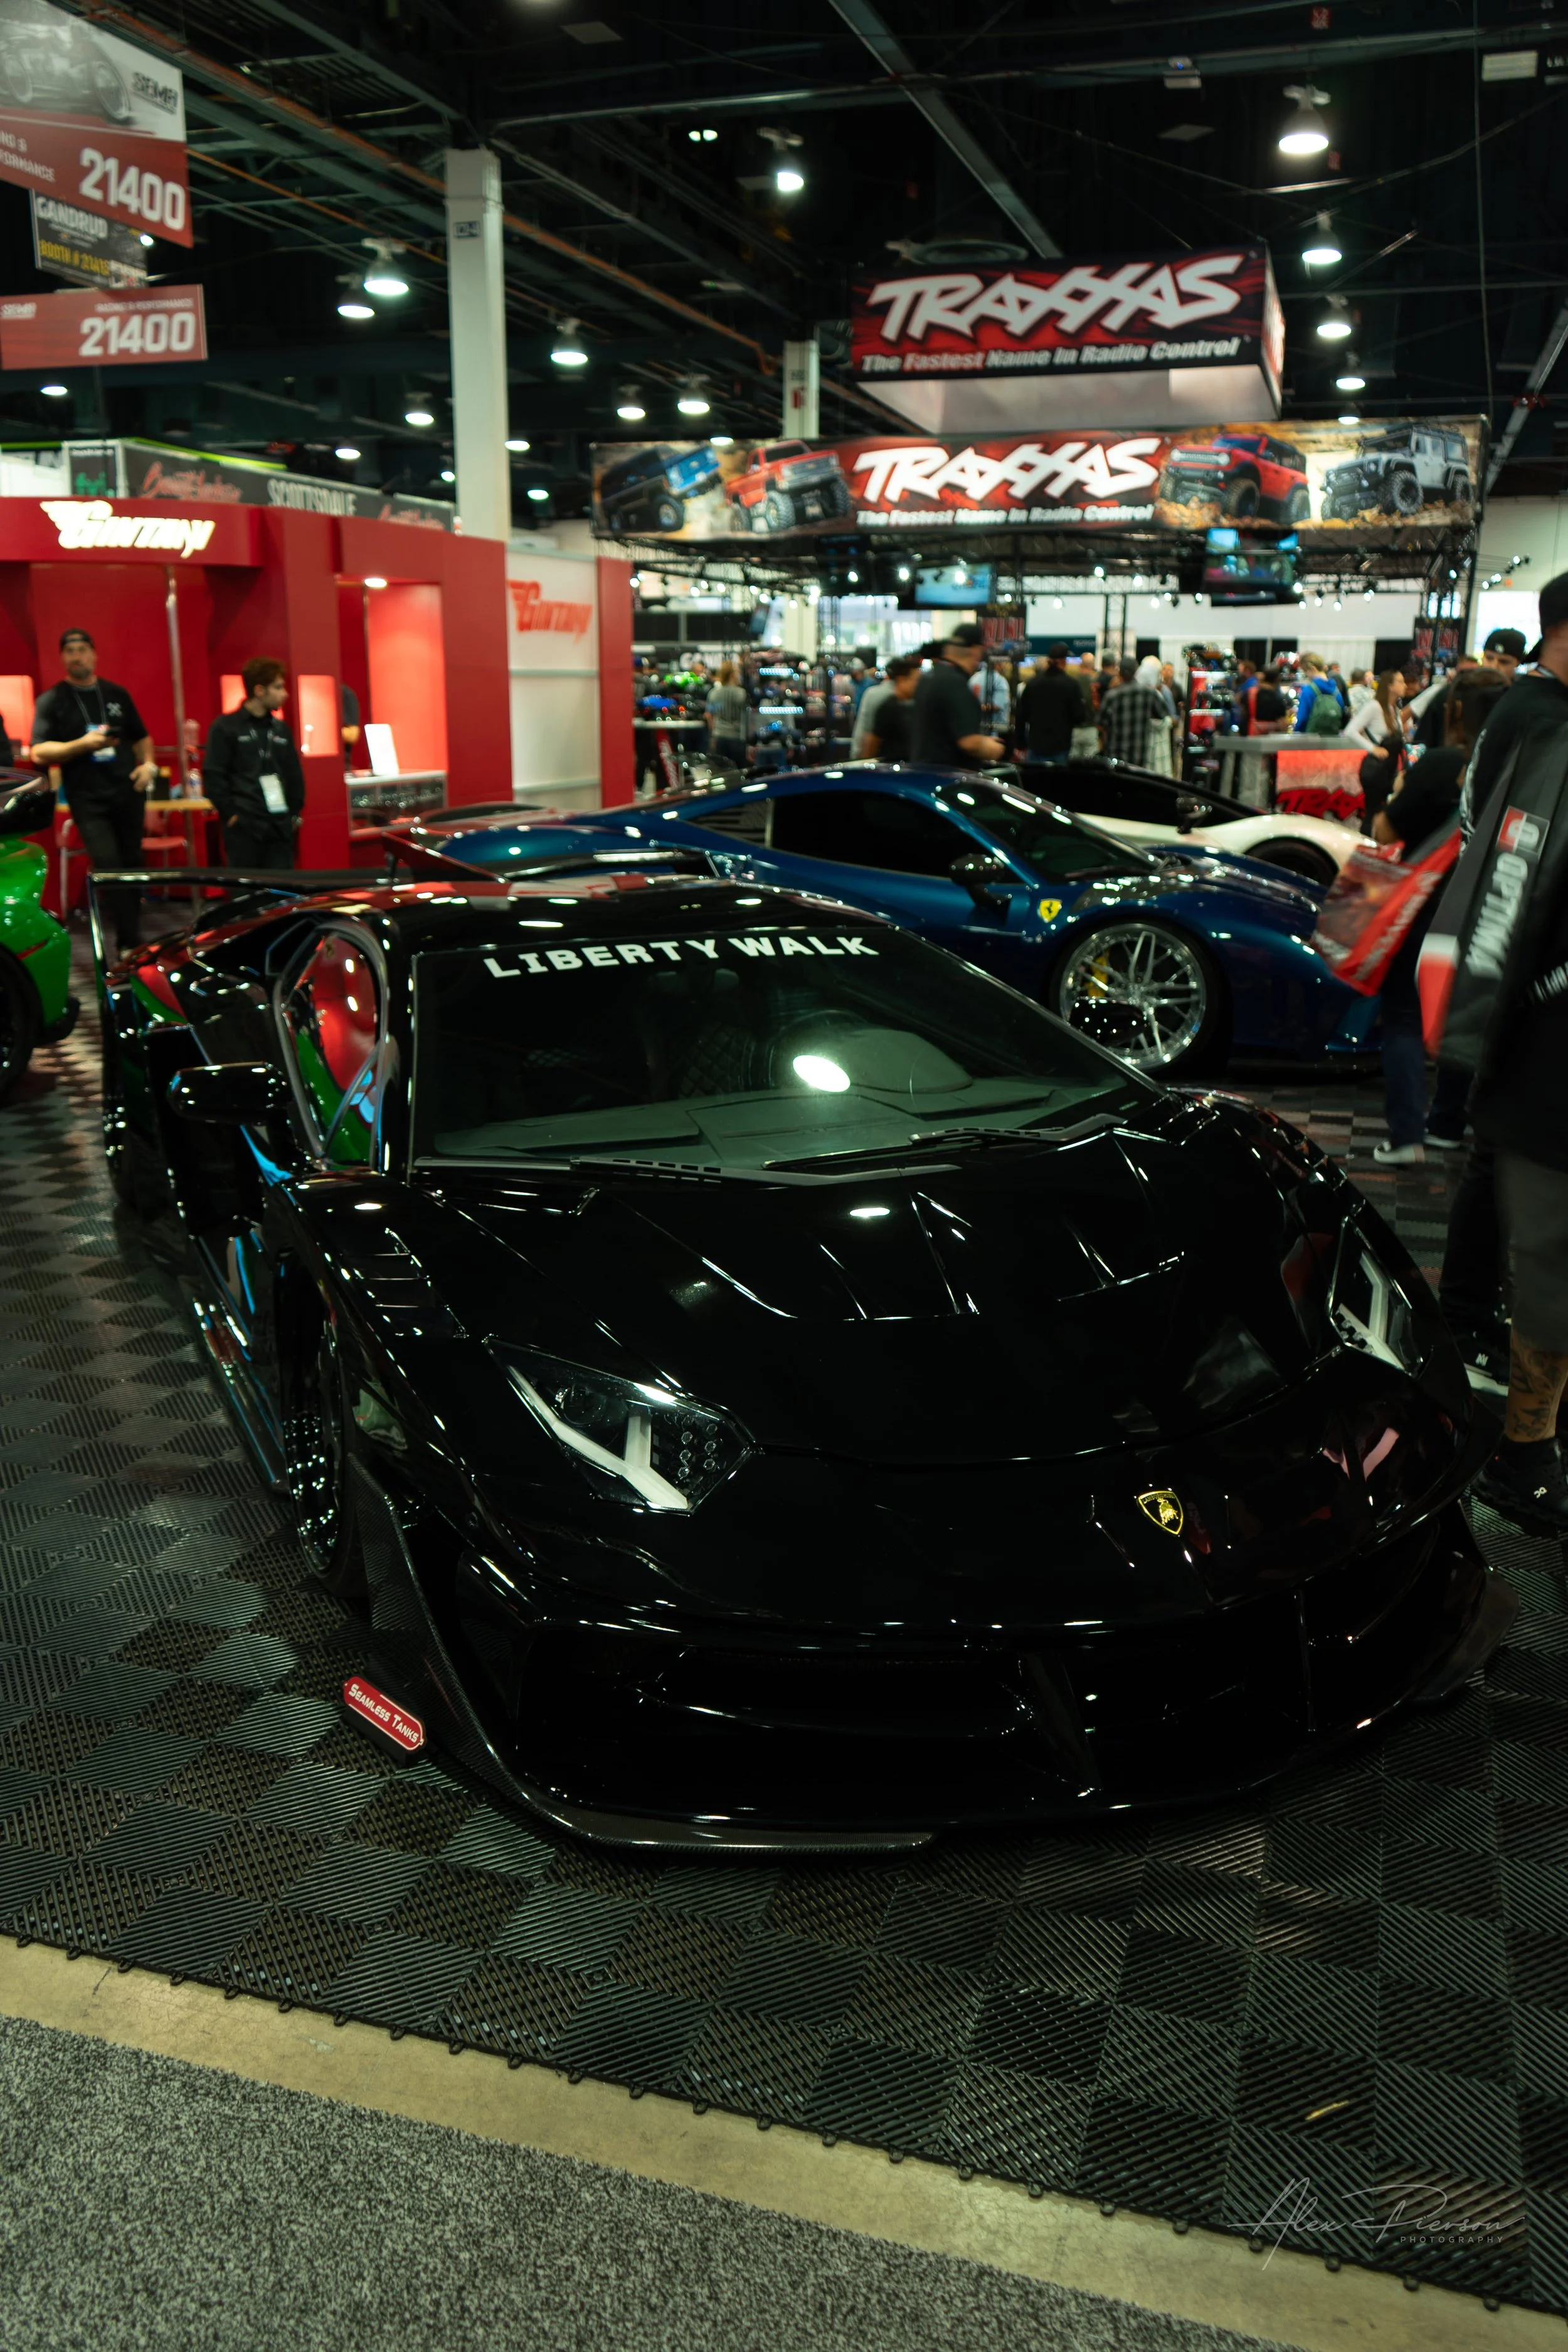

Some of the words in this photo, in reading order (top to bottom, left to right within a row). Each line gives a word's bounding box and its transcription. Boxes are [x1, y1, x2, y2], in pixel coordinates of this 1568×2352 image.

[79, 147, 185, 231] 21400
[867, 254, 1243, 342] TRAXXAS
[79, 312, 196, 356] 21400
[862, 354, 903, 371] The
[904, 351, 984, 369] Fastest
[985, 349, 1051, 367] Name
[1053, 347, 1078, 364] In
[1079, 343, 1147, 364] Radio
[1150, 337, 1239, 360] Control
[854, 437, 1163, 502] TRAXXAS
[267, 478, 358, 516] SCOTTSDALE
[856, 510, 889, 526] The
[889, 508, 953, 525] Fastest
[954, 507, 1007, 524] Name
[1008, 506, 1028, 522] In
[1029, 504, 1083, 522] Radio
[1083, 502, 1155, 521] Control
[1465, 852, 1528, 980] OPTIMA
[483, 939, 719, 978] LIBERTY
[728, 936, 880, 957] WALK
